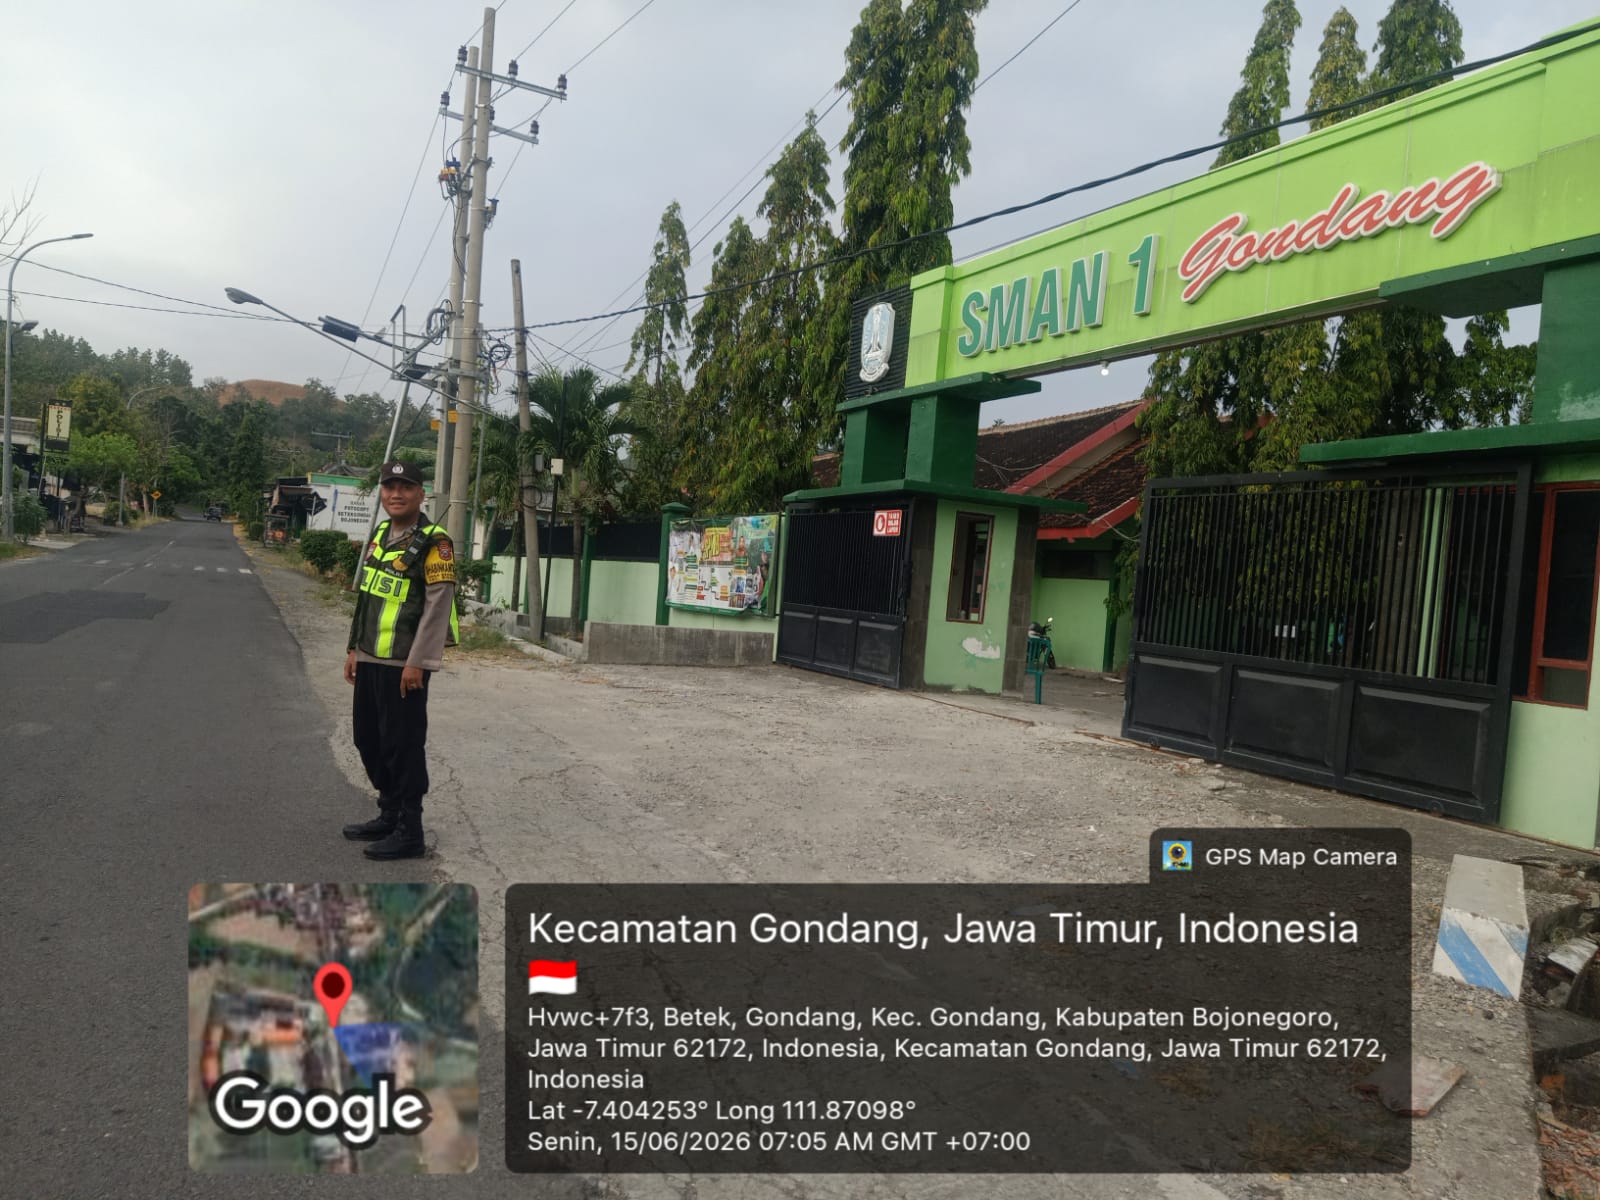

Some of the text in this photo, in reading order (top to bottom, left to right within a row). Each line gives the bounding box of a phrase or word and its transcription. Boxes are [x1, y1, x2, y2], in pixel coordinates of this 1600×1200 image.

[957, 161, 1501, 357] SMAN 1 Gondang
